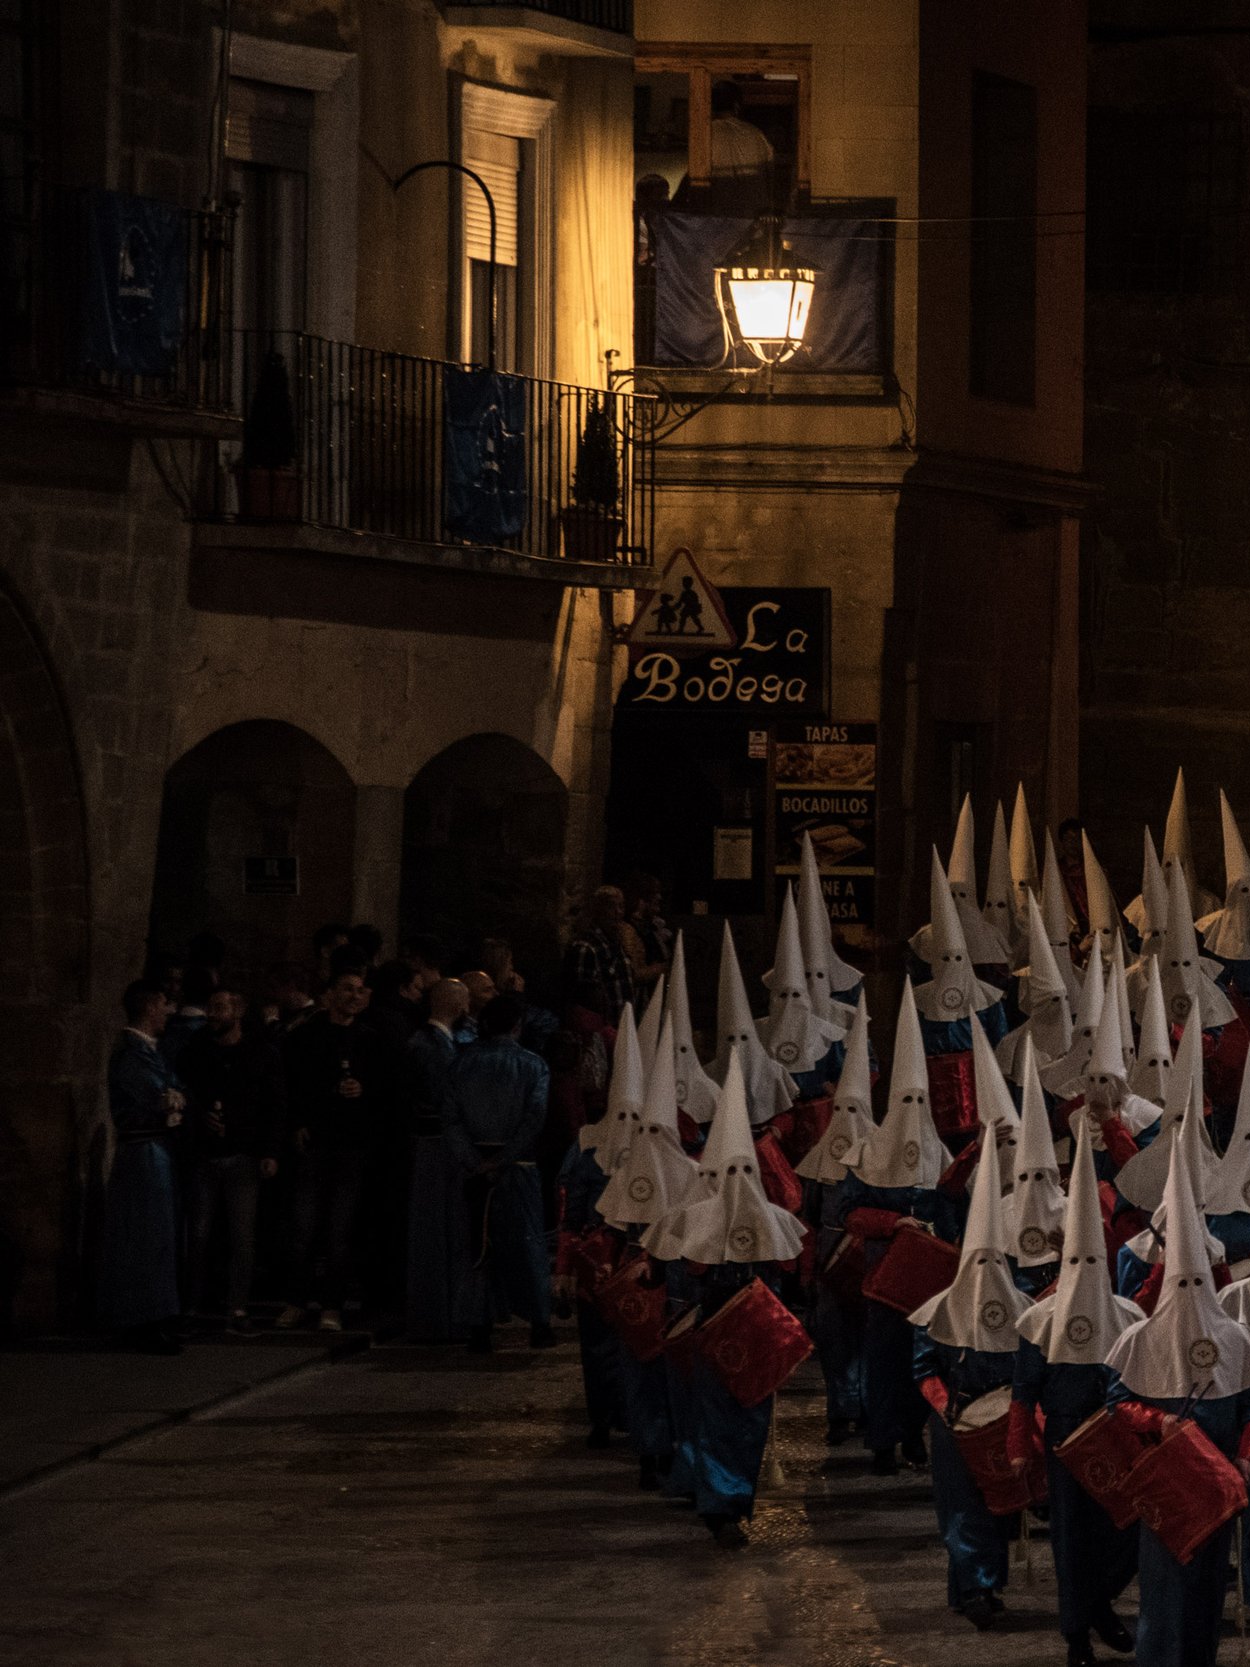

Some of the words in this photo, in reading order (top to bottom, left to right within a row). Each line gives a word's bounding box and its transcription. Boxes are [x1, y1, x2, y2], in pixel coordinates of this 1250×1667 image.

[740, 601, 809, 653] La
[632, 653, 808, 703] Bodega
[804, 725, 849, 742] TAPAS
[781, 797, 869, 814] BOCADILLOS
